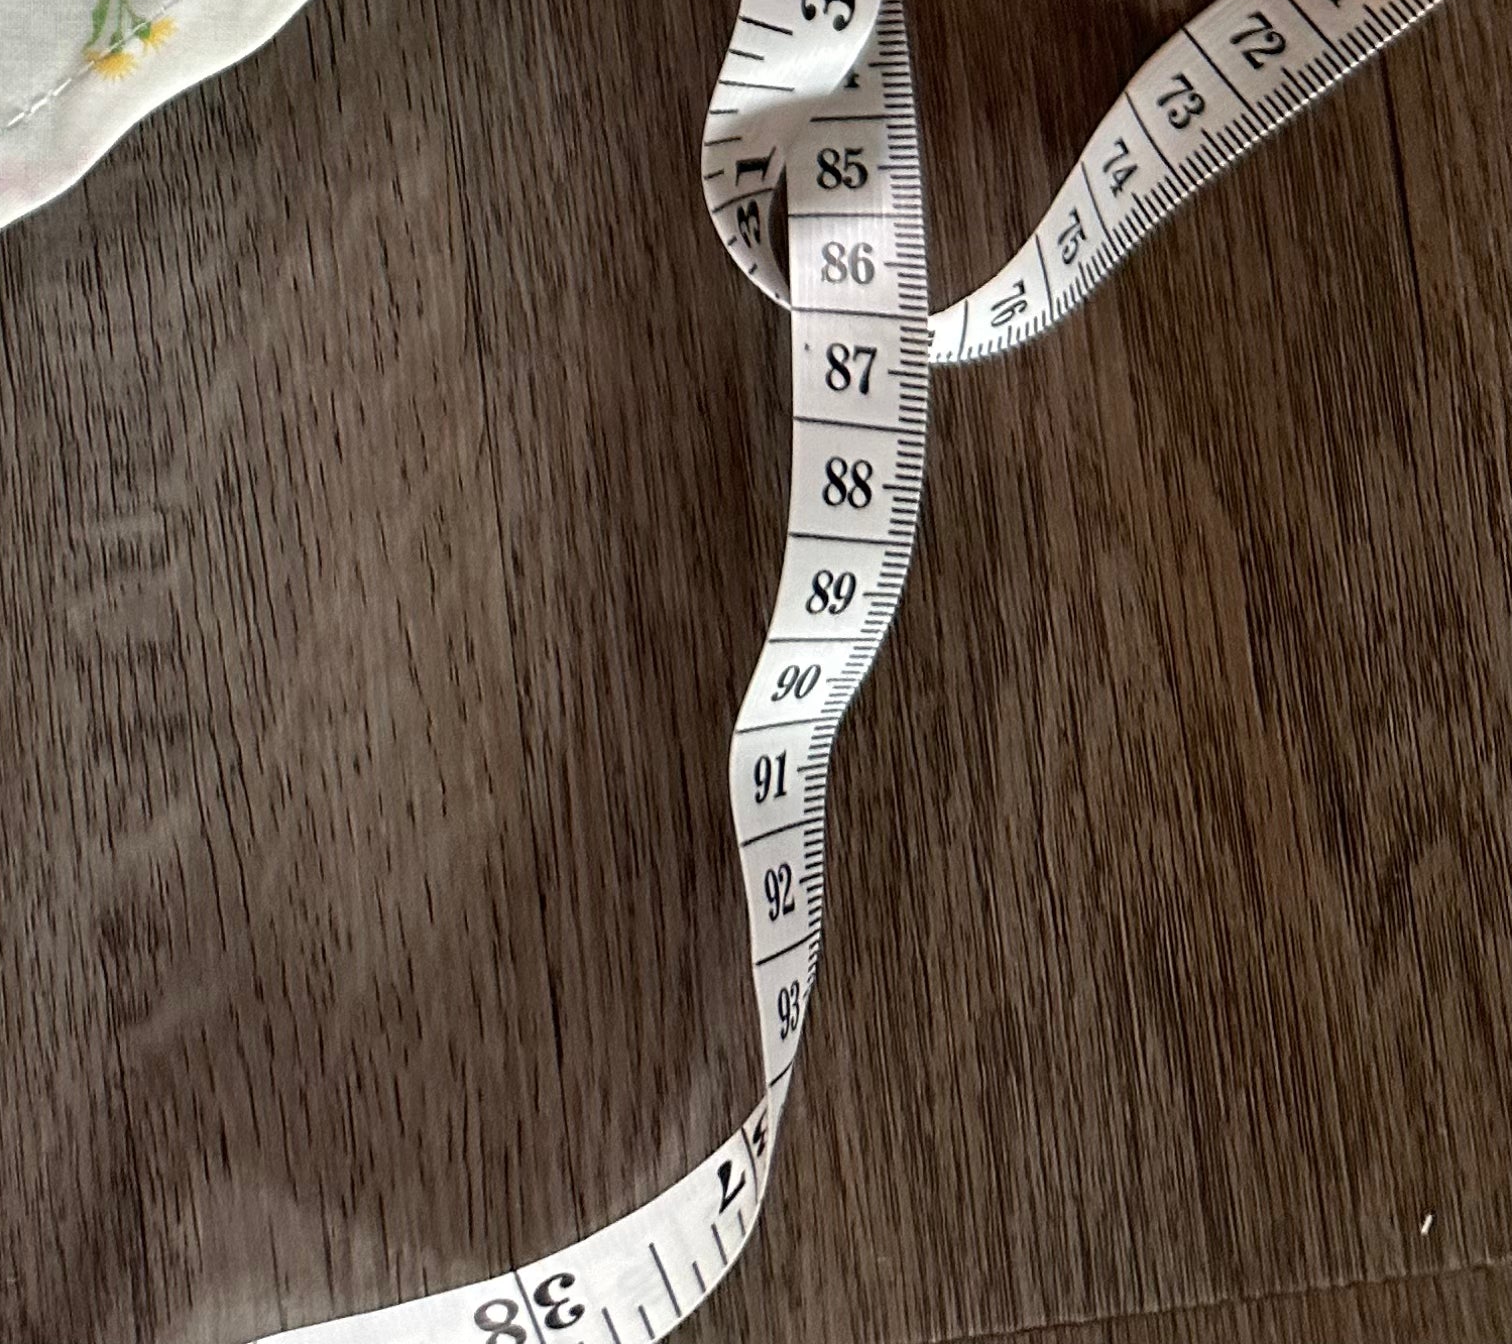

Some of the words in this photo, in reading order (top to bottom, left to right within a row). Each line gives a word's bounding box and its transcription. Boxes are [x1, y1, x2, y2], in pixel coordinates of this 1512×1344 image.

[1229, 11, 1287, 70] 72
[1156, 73, 1206, 130] 73
[816, 147, 868, 190] 85
[1101, 140, 1138, 197] 74
[820, 241, 875, 285] 86
[1056, 208, 1089, 265] 75
[989, 280, 1028, 327] 76
[825, 343, 877, 395] 87
[822, 457, 874, 509] 88
[805, 569, 857, 615] 89
[771, 664, 822, 702] 90
[753, 749, 787, 804] 91
[764, 863, 796, 922] 92
[777, 980, 800, 1041] 93
